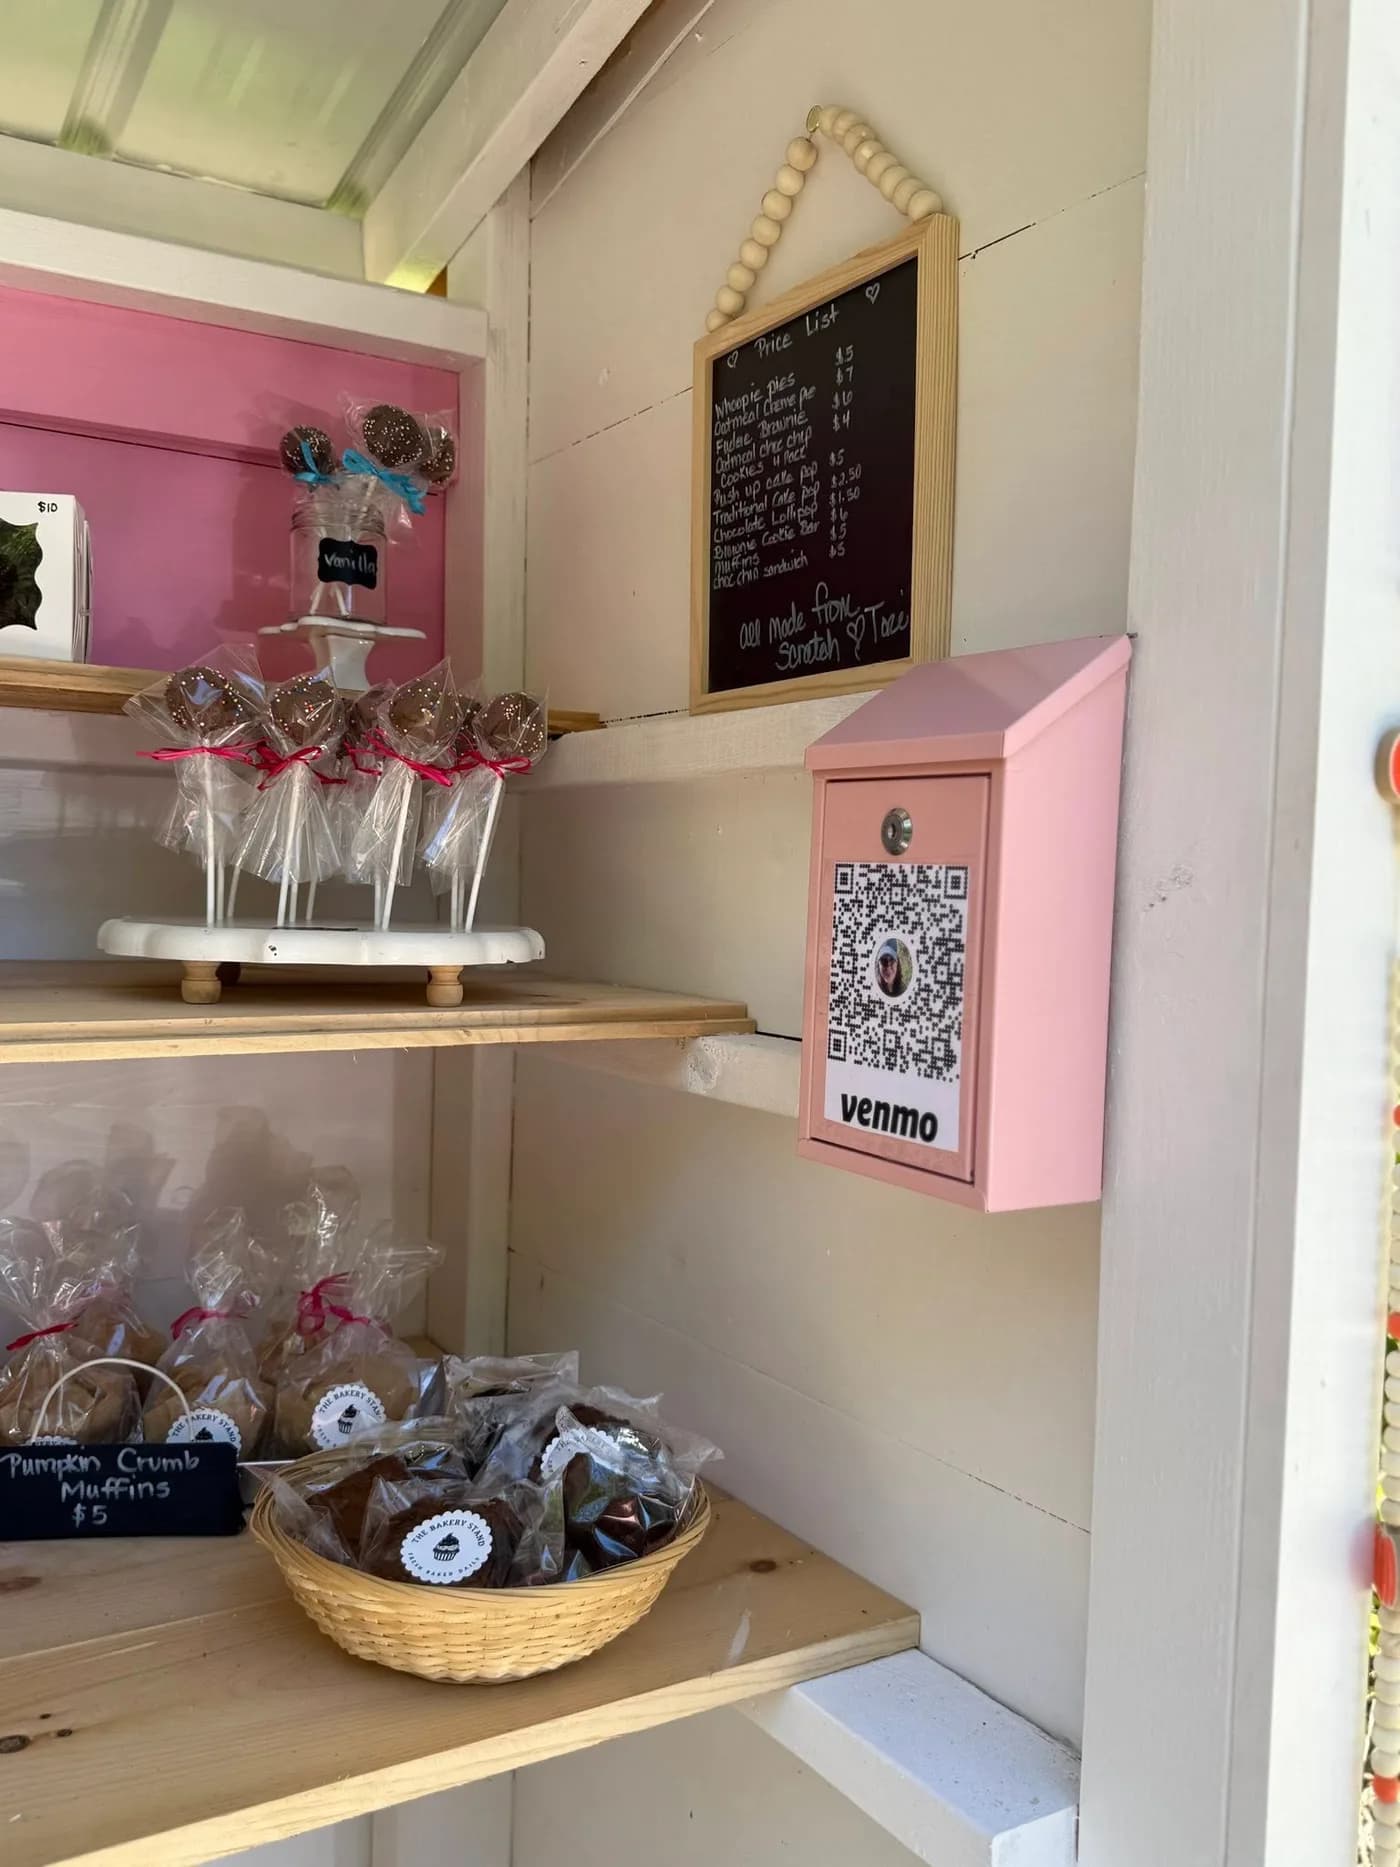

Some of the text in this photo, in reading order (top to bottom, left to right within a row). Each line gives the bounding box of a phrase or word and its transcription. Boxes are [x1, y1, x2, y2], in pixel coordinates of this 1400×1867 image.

[754, 304, 839, 358] Price List
[714, 402, 759, 436] Oatmeal
[837, 366, 853, 386] $7
[715, 345, 853, 419] Whoopie pies $5
[758, 409, 809, 439] Brownie
[832, 391, 853, 411] $6
[716, 443, 757, 474] Oatmeal
[832, 410, 850, 432] $4
[712, 494, 768, 526] Traditional
[801, 481, 820, 505] pop
[831, 464, 862, 489] $2.50
[713, 487, 740, 507] Push
[745, 481, 761, 501] up
[800, 461, 818, 486] pop
[830, 449, 845, 467] $5
[720, 463, 764, 489] Cookies
[37, 501, 58, 513] $10
[714, 515, 766, 543] Chocolate
[830, 487, 860, 507] $1.50
[830, 523, 847, 541] $5
[763, 549, 808, 577] sandwich
[829, 541, 845, 559] $5
[811, 581, 860, 624] from
[841, 1093, 938, 1143] venmo
[319, 1398, 333, 1413] THE
[333, 1390, 367, 1400] BAKERY
[0, 1446, 200, 1480] Pumpkin Crumb
[62, 1473, 171, 1502] Muffins
[72, 1503, 108, 1528] $5
[411, 1519, 486, 1547] THE BAKERY STAND
